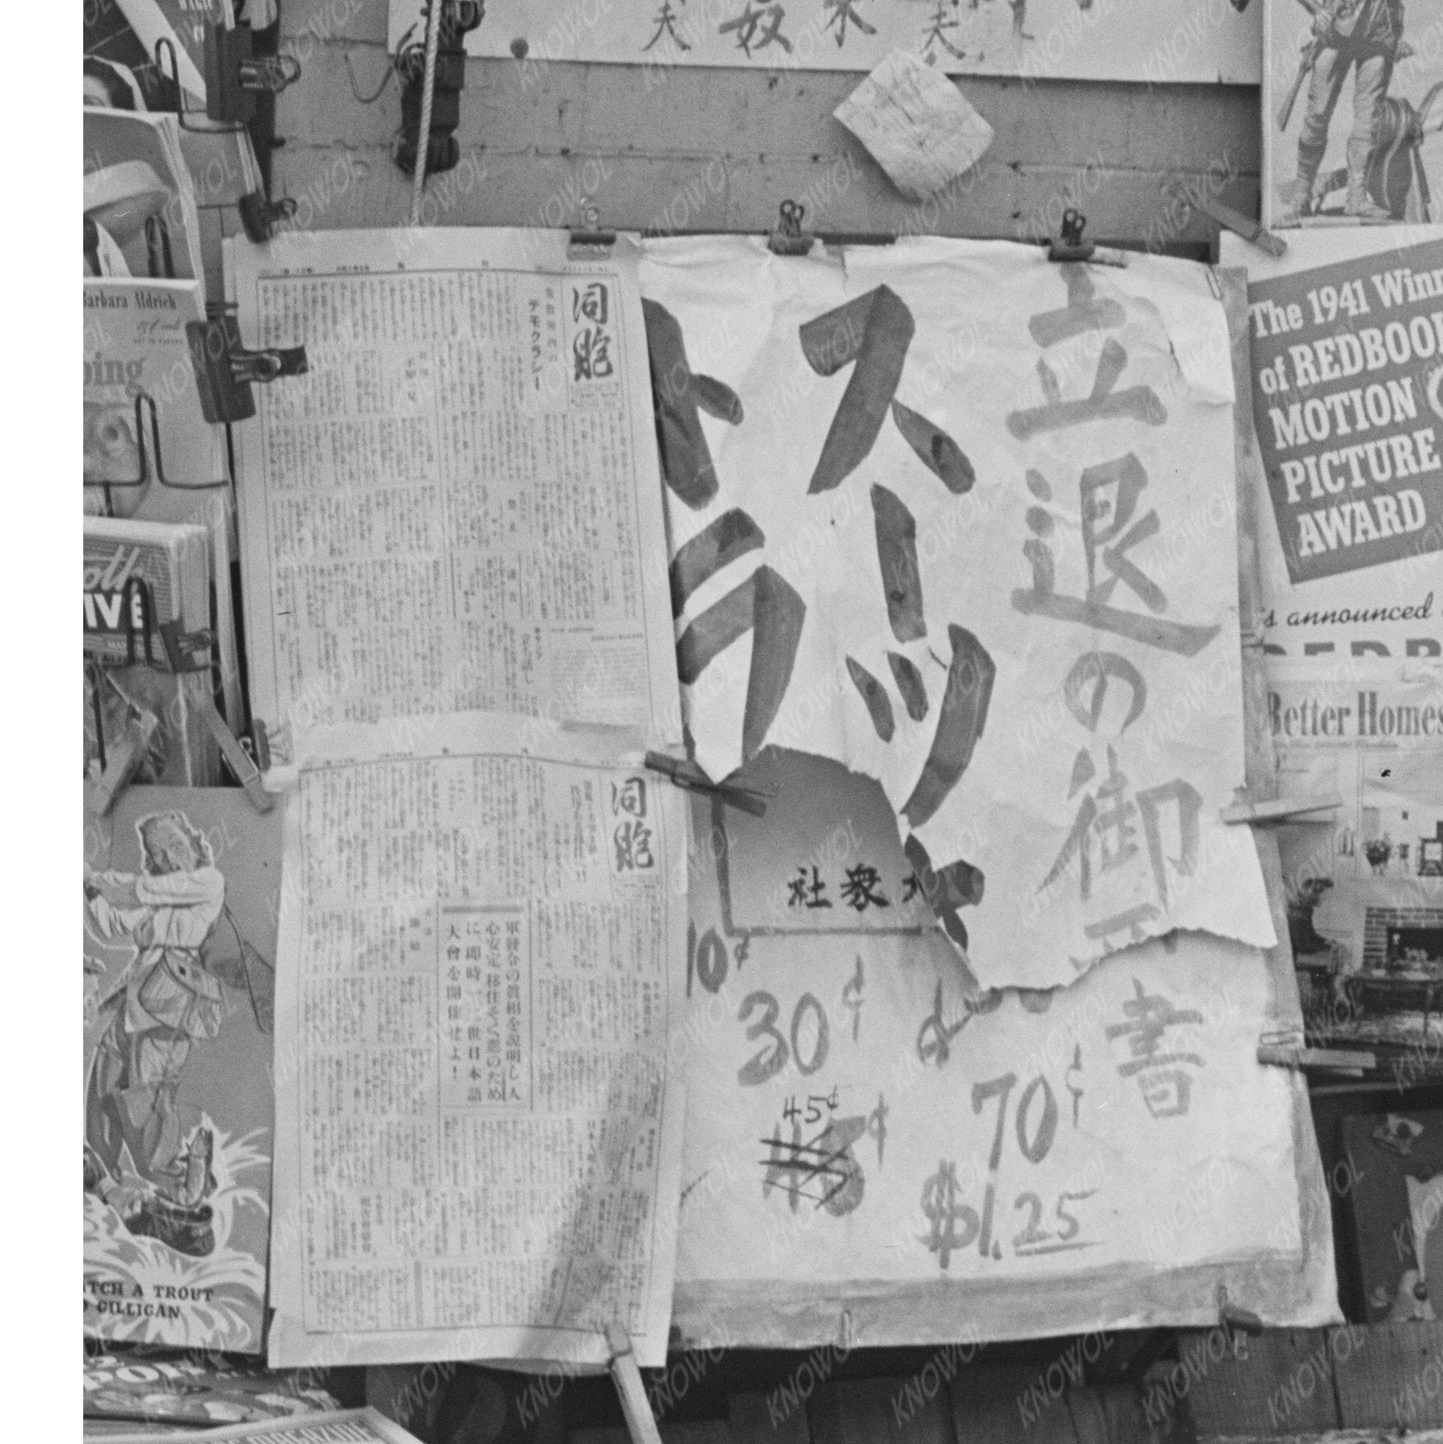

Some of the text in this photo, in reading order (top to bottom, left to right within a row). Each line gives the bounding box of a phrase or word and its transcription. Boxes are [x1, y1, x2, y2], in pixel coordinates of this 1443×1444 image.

[1250, 300, 1303, 338] The
[1308, 280, 1371, 325] 1941
[1259, 354, 1290, 395] of
[1268, 377, 1419, 450] MOTION
[1280, 427, 1442, 504] PICTURE
[1297, 488, 1428, 559] AWARD
[1286, 591, 1434, 628] announced
[1267, 690, 1352, 738] Better
[737, 952, 867, 1087] 30¢
[971, 1042, 1086, 1172] 70¢
[919, 1159, 1104, 1271] $1.25
[97, 1298, 181, 1320] GILLIGAN
[132, 1281, 215, 1301] A TROUT
